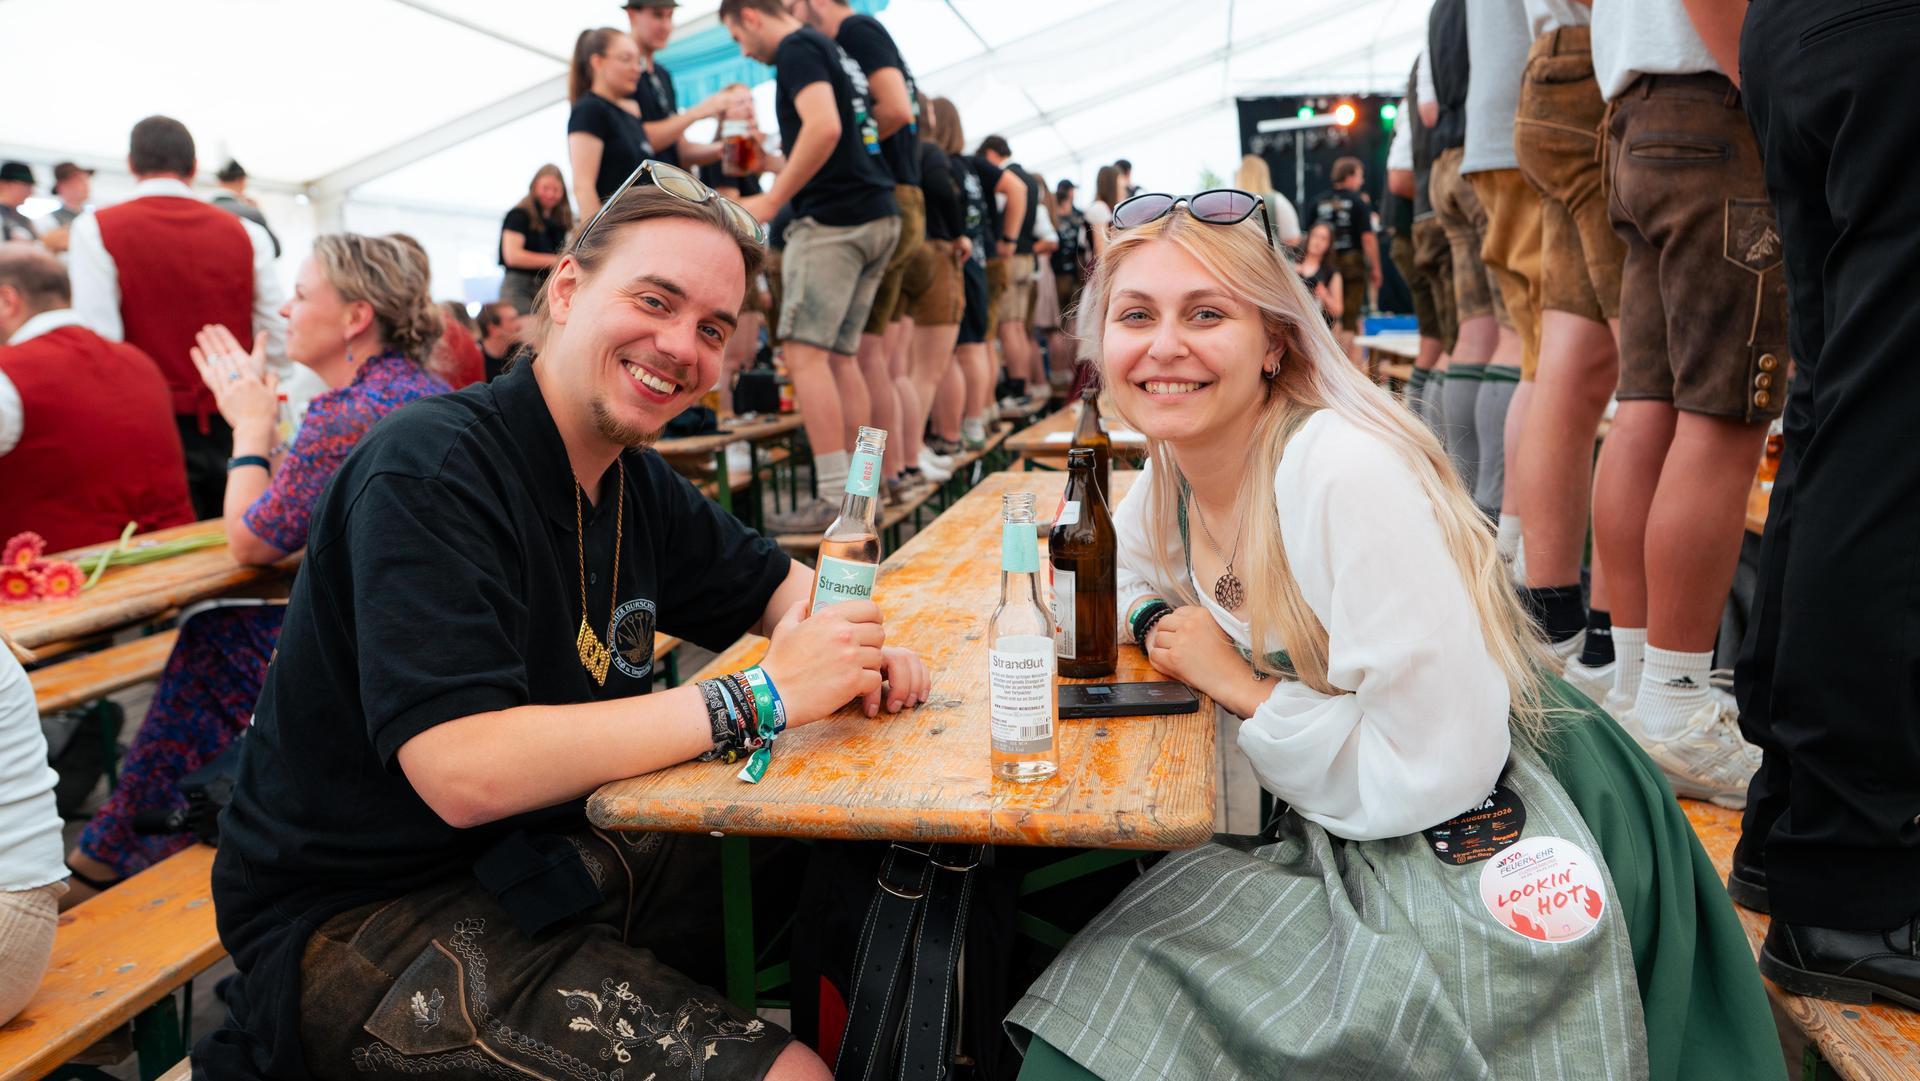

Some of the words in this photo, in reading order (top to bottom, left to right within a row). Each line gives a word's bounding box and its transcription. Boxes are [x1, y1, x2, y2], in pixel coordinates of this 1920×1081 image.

[819, 575, 872, 597] Strandgut
[993, 655, 1044, 669] Strandgut
[1460, 812, 1491, 824] AUGUST
[1503, 851, 1522, 865] 150
[1538, 884, 1584, 915] HOT
